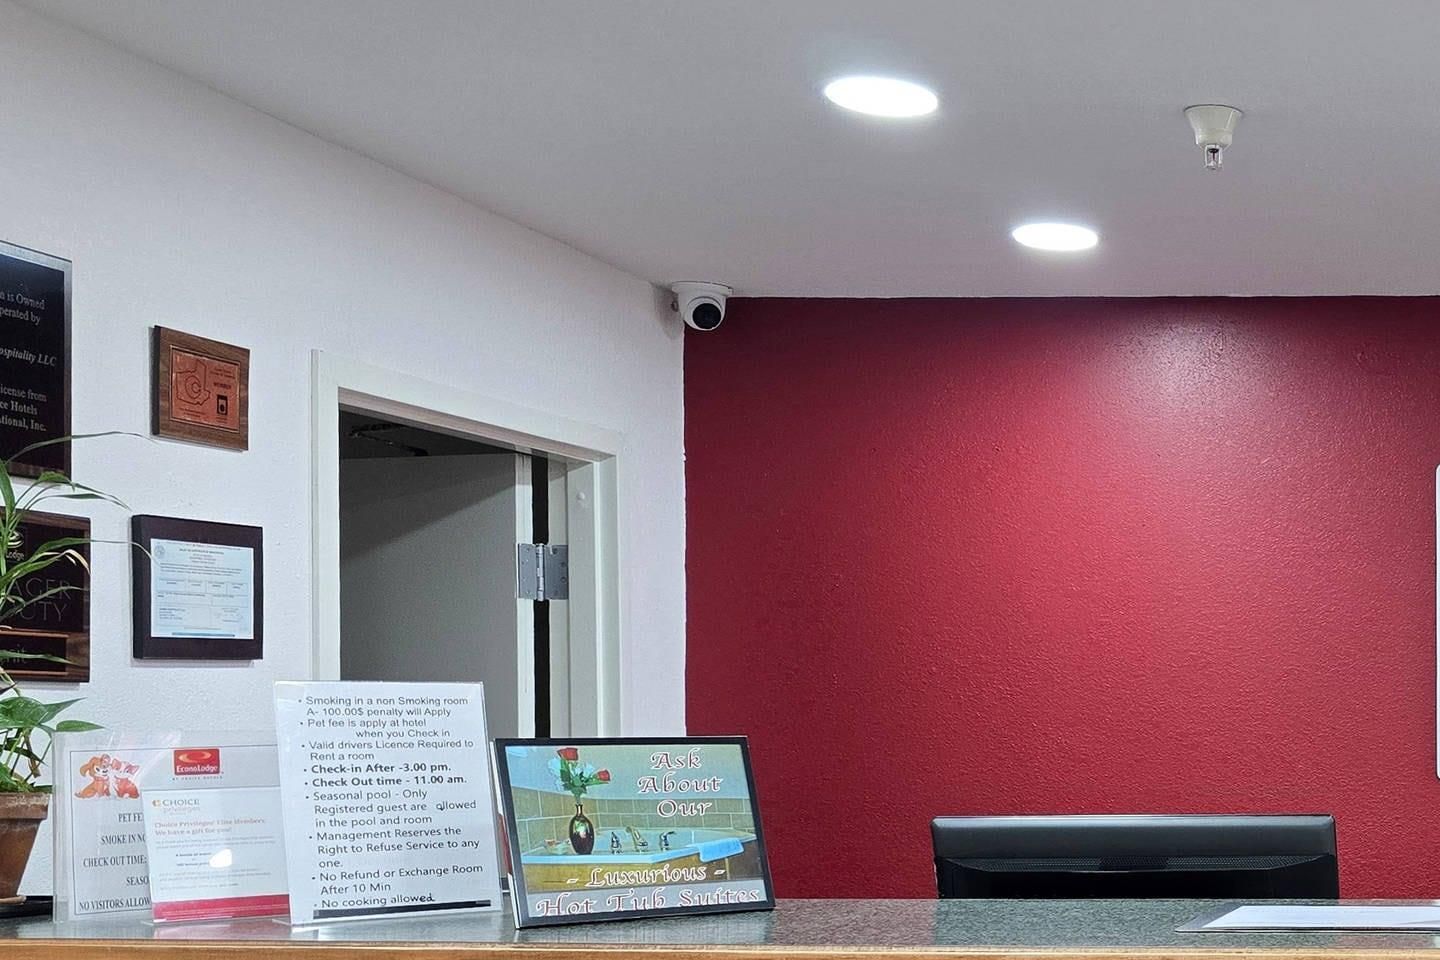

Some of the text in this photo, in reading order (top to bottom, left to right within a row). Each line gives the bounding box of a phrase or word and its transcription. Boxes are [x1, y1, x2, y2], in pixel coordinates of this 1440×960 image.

[7, 290, 14, 302] is
[16, 293, 45, 310] Owned
[0, 307, 41, 326] perated by
[37, 353, 57, 367] LLC
[28, 388, 47, 402] from
[11, 400, 37, 416] Hotels
[0, 415, 47, 432] tional, Inc.
[306, 696, 351, 706] Smoking
[354, 696, 364, 705] in
[398, 697, 440, 706] Smoking
[306, 708, 451, 717] A- 100.00$ penalty will Apply
[308, 719, 426, 728] Pet fee is apply at hotel
[386, 731, 404, 739] you
[408, 729, 439, 737] Check
[442, 729, 450, 737] in
[309, 740, 474, 749] Valid drivers Licence Required to
[310, 752, 335, 760] Rent
[650, 747, 703, 770] Ask
[311, 763, 451, 773] Check-in After -3.00 pm.
[312, 777, 348, 787] Check
[351, 777, 373, 786] Out
[377, 776, 402, 786] time
[414, 775, 444, 784] 11.00
[447, 776, 467, 784] am.
[637, 771, 723, 795] About
[313, 791, 362, 801] Seasonal
[366, 790, 391, 800] pool
[403, 789, 427, 799] Only
[314, 804, 373, 816] Registered
[377, 803, 407, 814] guest
[436, 800, 477, 811] allowed
[657, 799, 713, 818] Our
[118, 813, 131, 823] PET
[315, 816, 432, 828] in the pool and room
[100, 834, 126, 845] SMOKE
[128, 834, 136, 844] IN
[317, 827, 461, 841] Management Reserves the
[318, 840, 480, 856] Right to Refuse Service to any
[83, 855, 147, 868] CHECK OUT TIME:
[319, 860, 343, 868] one.
[320, 865, 483, 881] No Refund or Exchange Room
[585, 863, 707, 888] Luxurious
[321, 883, 391, 895] After 10 Min
[80, 896, 152, 911] NO VISITORS ALLOW
[322, 899, 338, 908] No
[342, 897, 387, 907] cooking
[535, 887, 761, 916] Hot Tub Suites
